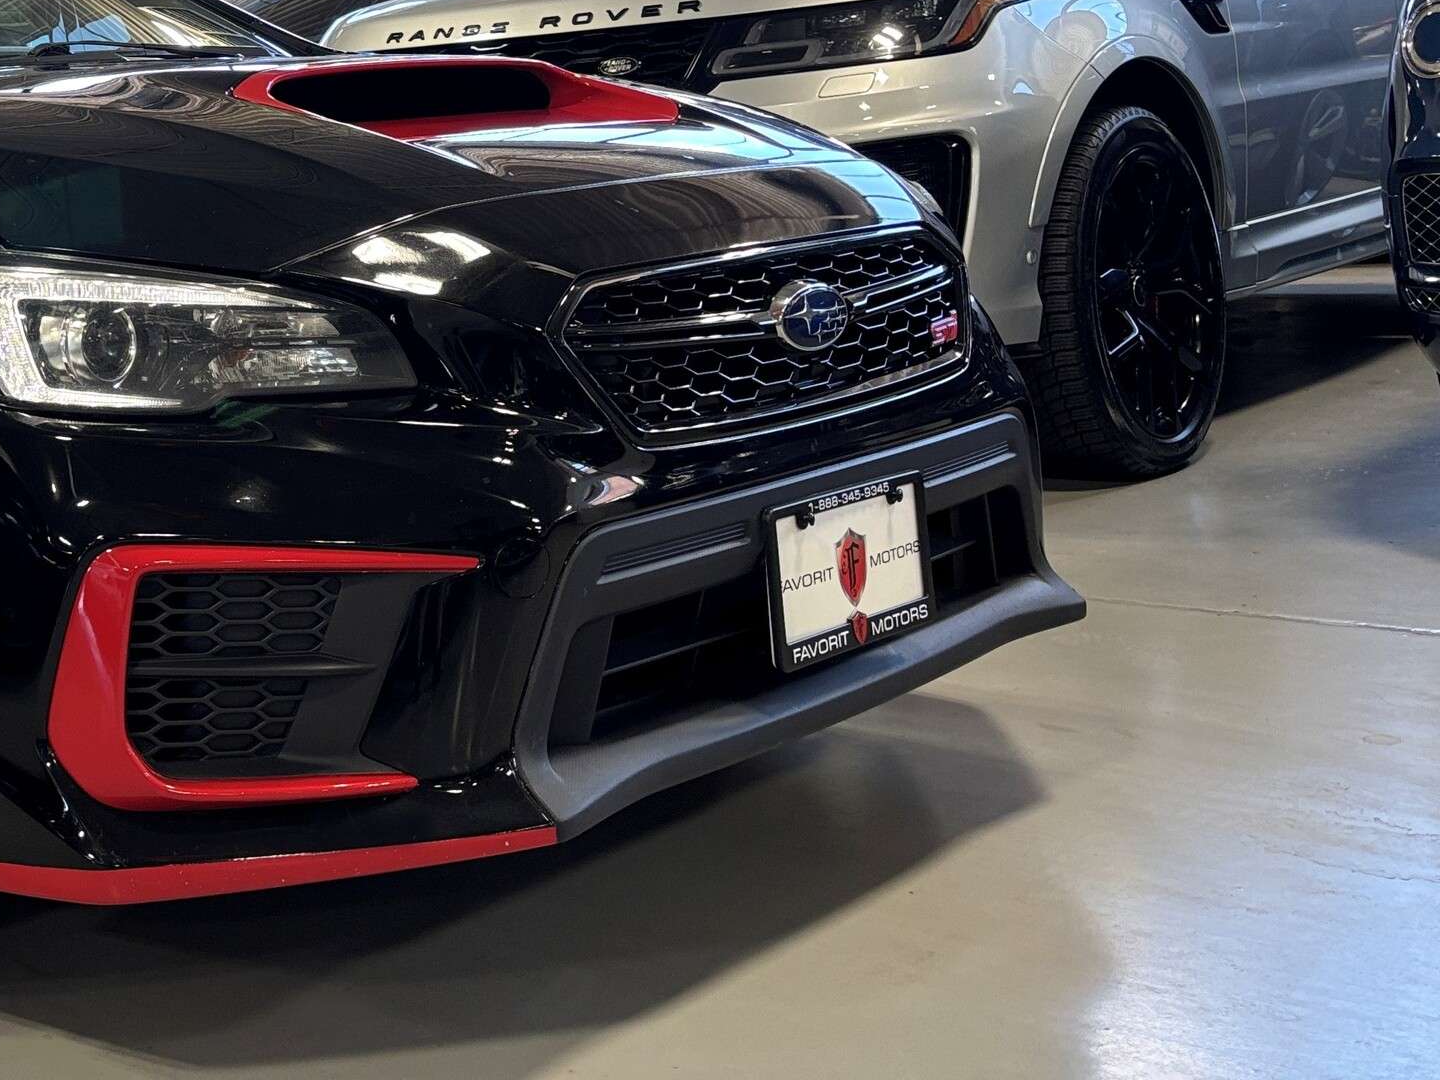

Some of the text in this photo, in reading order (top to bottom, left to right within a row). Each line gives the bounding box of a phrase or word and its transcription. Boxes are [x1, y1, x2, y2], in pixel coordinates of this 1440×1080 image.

[386, 0, 702, 44] RANGE ROVER
[807, 482, 890, 514] 1-888-345-9345
[780, 567, 834, 594] AVORIT
[869, 539, 921, 568] MOTORS
[793, 630, 850, 664] FAVORIT
[871, 604, 929, 636] MOTORS
